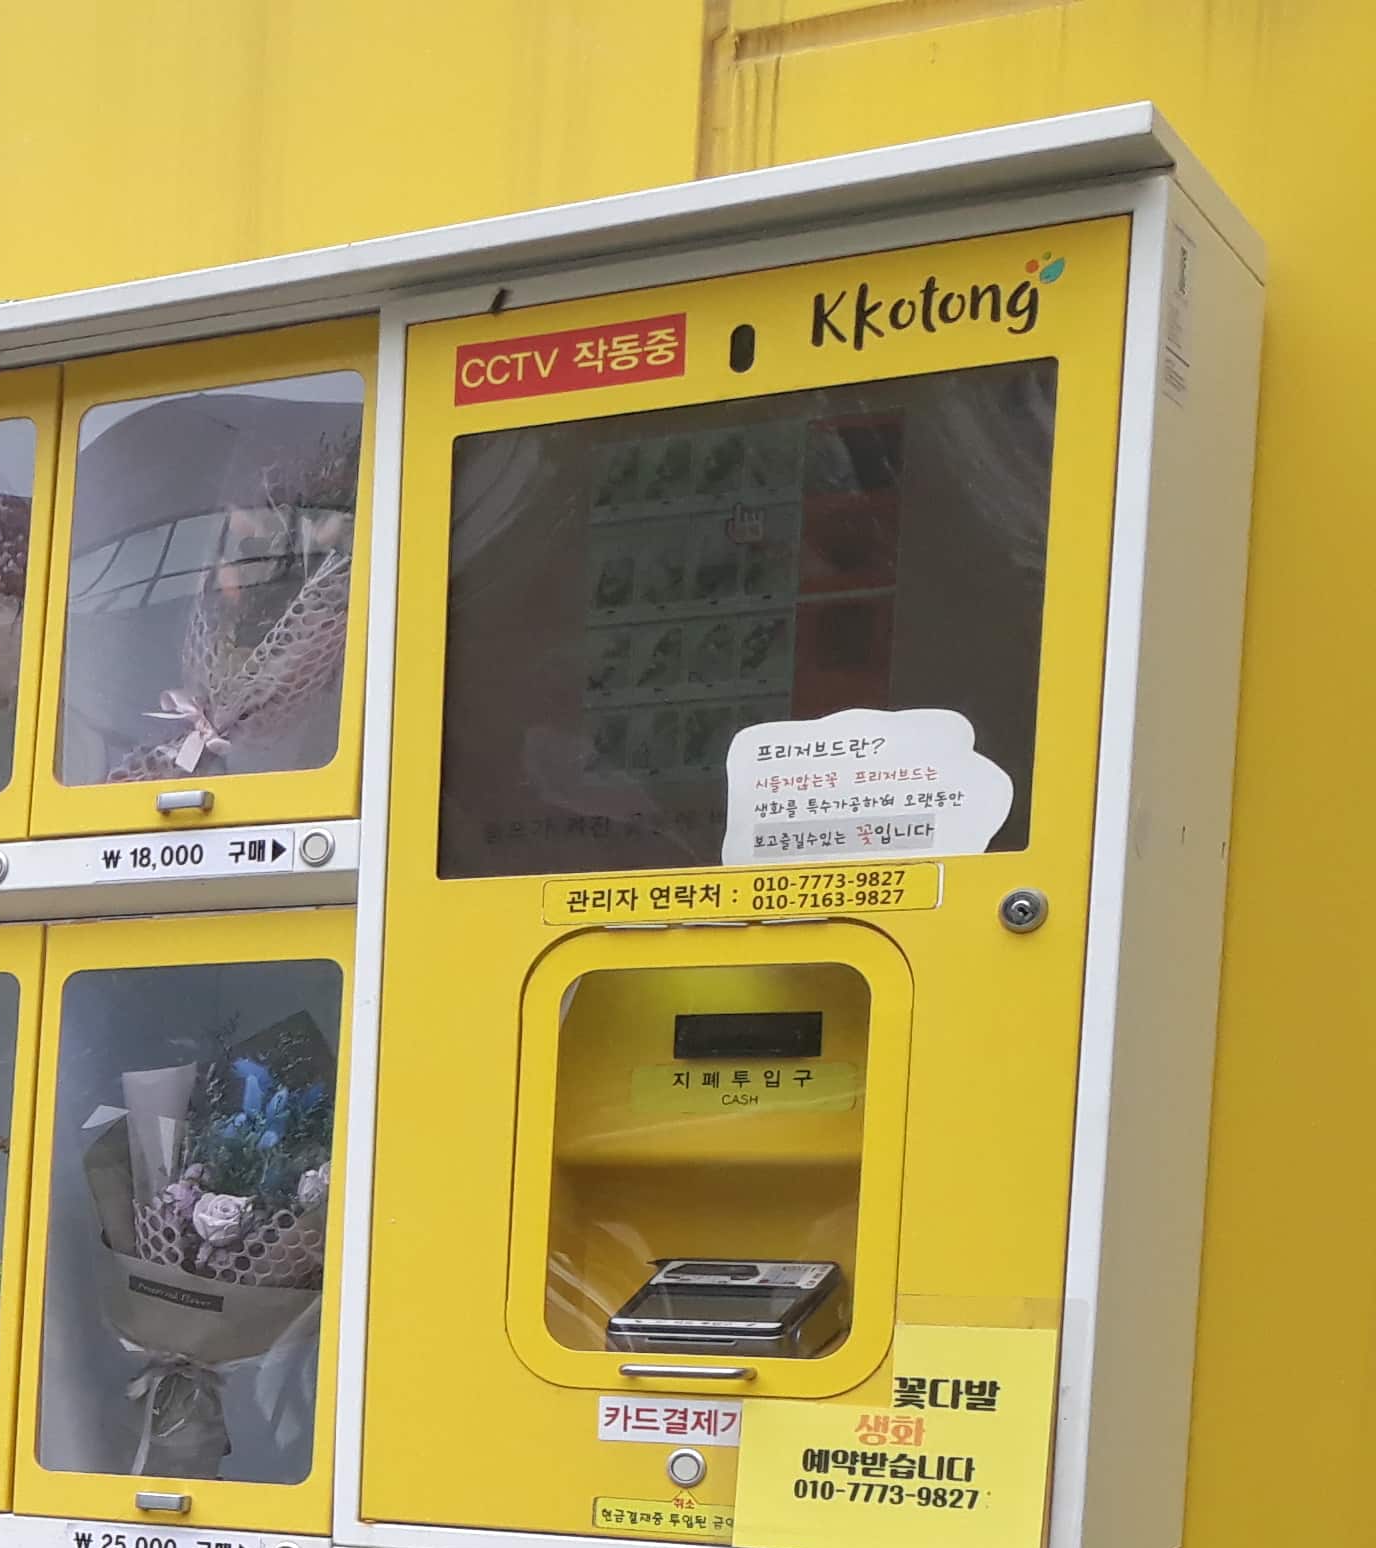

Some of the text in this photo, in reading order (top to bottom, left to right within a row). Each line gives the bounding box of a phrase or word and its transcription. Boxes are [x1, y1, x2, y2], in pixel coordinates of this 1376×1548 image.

[811, 276, 1040, 351] Kkotong
[461, 327, 679, 390] CCTV 작동중
[756, 738, 886, 762] 프리저브드란?
[854, 767, 939, 786] 프리저브드는
[754, 797, 798, 819] 생화를
[855, 821, 934, 847] 꽃입니다
[103, 840, 265, 869] ₩ 18,000 구매
[753, 870, 906, 893] 010-7773-9827
[566, 887, 638, 914] 관리자
[649, 882, 721, 912] 연락처
[752, 889, 905, 912] 010-7163-9827
[721, 1094, 759, 1106] CASH
[893, 1376, 1001, 1412] 꽃다발
[854, 1414, 926, 1448] 생화
[801, 1448, 976, 1484] 예약받습니다
[793, 1479, 979, 1510] 010-7773-9827
[669, 1512, 708, 1531] 투입된
